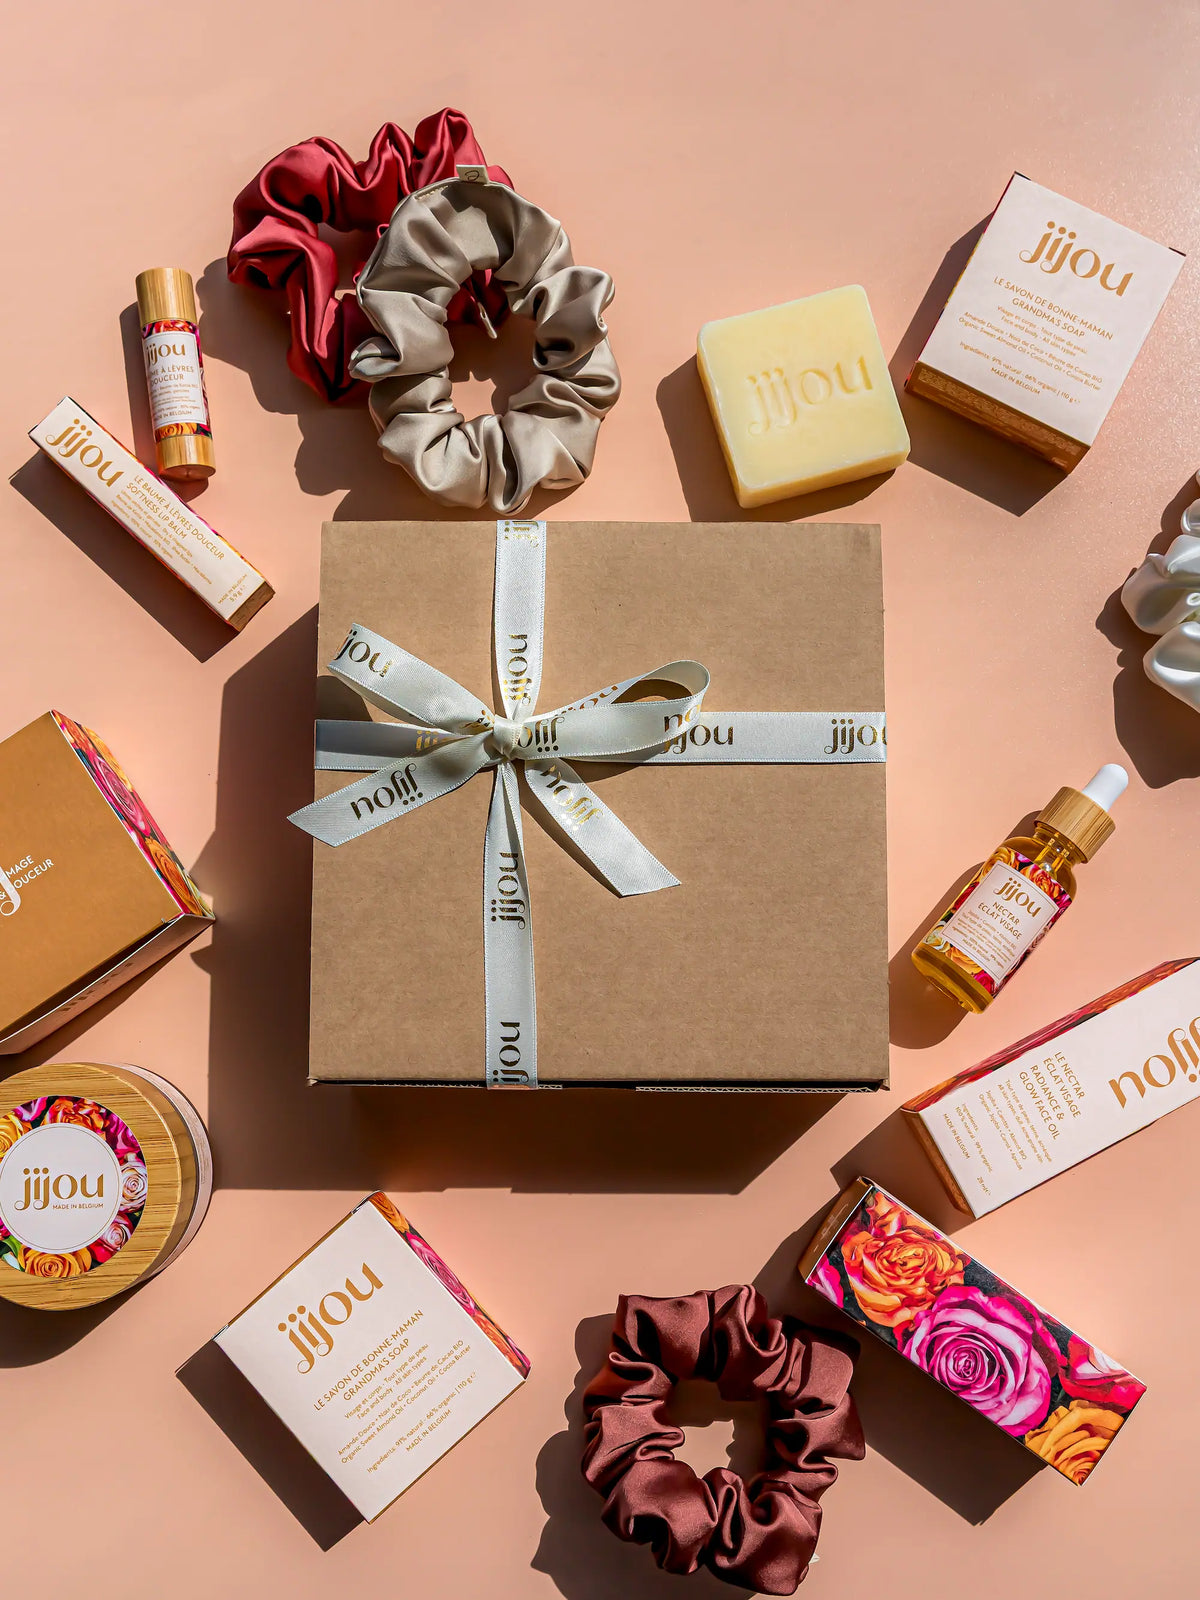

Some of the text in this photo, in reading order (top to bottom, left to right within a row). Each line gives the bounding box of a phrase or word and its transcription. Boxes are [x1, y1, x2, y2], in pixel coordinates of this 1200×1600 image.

[1018, 220, 1133, 296] jijou
[993, 276, 1113, 340] LE SAVON DE BONNE-MAMAN
[1011, 297, 1085, 337] GRANDMA'S SOAP
[146, 343, 186, 366] jijou
[168, 364, 194, 373] LÈVRES
[990, 366, 1008, 378] MADE
[1014, 378, 1040, 394] BELGIUM
[746, 355, 874, 436] jijou
[44, 418, 124, 487] jijou
[126, 482, 187, 538] SOFTNESS LIP BALM
[141, 482, 166, 504] BAUME
[168, 507, 192, 530] LÈVRES
[190, 527, 224, 560] DOUCEUR
[504, 520, 540, 548] jij
[335, 629, 394, 678] jou
[503, 633, 532, 706] jijou
[516, 716, 566, 752] jijo
[658, 724, 734, 754] jou
[350, 762, 424, 820] jijou
[540, 764, 604, 832] jijou
[491, 852, 526, 930] jijou
[992, 901, 1019, 925] NECTAR
[993, 876, 1041, 917] jijou
[999, 917, 1022, 940] VISAGE
[492, 1022, 530, 1084] ijou
[1054, 1051, 1085, 1099] LE NECTAR
[978, 1093, 991, 1112] Organic
[1018, 1071, 1060, 1140] GLOW FACE OIL
[1029, 1064, 1061, 1112] RADIANCE
[1042, 1057, 1081, 1117] ÉCLAT VISAGE
[943, 1113, 954, 1129] MADE
[954, 1135, 970, 1159] BELGIUM
[14, 1168, 104, 1210] jijou
[277, 1262, 383, 1374] jijou
[313, 1309, 424, 1411] LE SAVON DE BONNE-MAMAN
[342, 1337, 409, 1400] GRANDMA'S SOAP
[367, 1385, 382, 1399] corps
[383, 1371, 397, 1383] Tout
[395, 1361, 408, 1373] type
[414, 1343, 428, 1358] peau
[337, 1436, 359, 1455] Amande
[357, 1421, 375, 1437] Douce
[452, 1339, 463, 1351] BIO
[340, 1444, 362, 1463] Organic
[359, 1431, 376, 1446] Sweet
[375, 1412, 396, 1432] Almond
[394, 1405, 404, 1415] Oil
[405, 1384, 428, 1404] Coconut
[426, 1376, 436, 1385] Oil
[453, 1344, 470, 1360] Butter
[356, 1407, 370, 1419] Face
[369, 1396, 380, 1409] and
[377, 1386, 393, 1400] body
[394, 1436, 407, 1446] 91%
[456, 1380, 467, 1389] 110
[405, 1435, 422, 1451] MADE
[427, 1408, 451, 1431] BELGIUM
